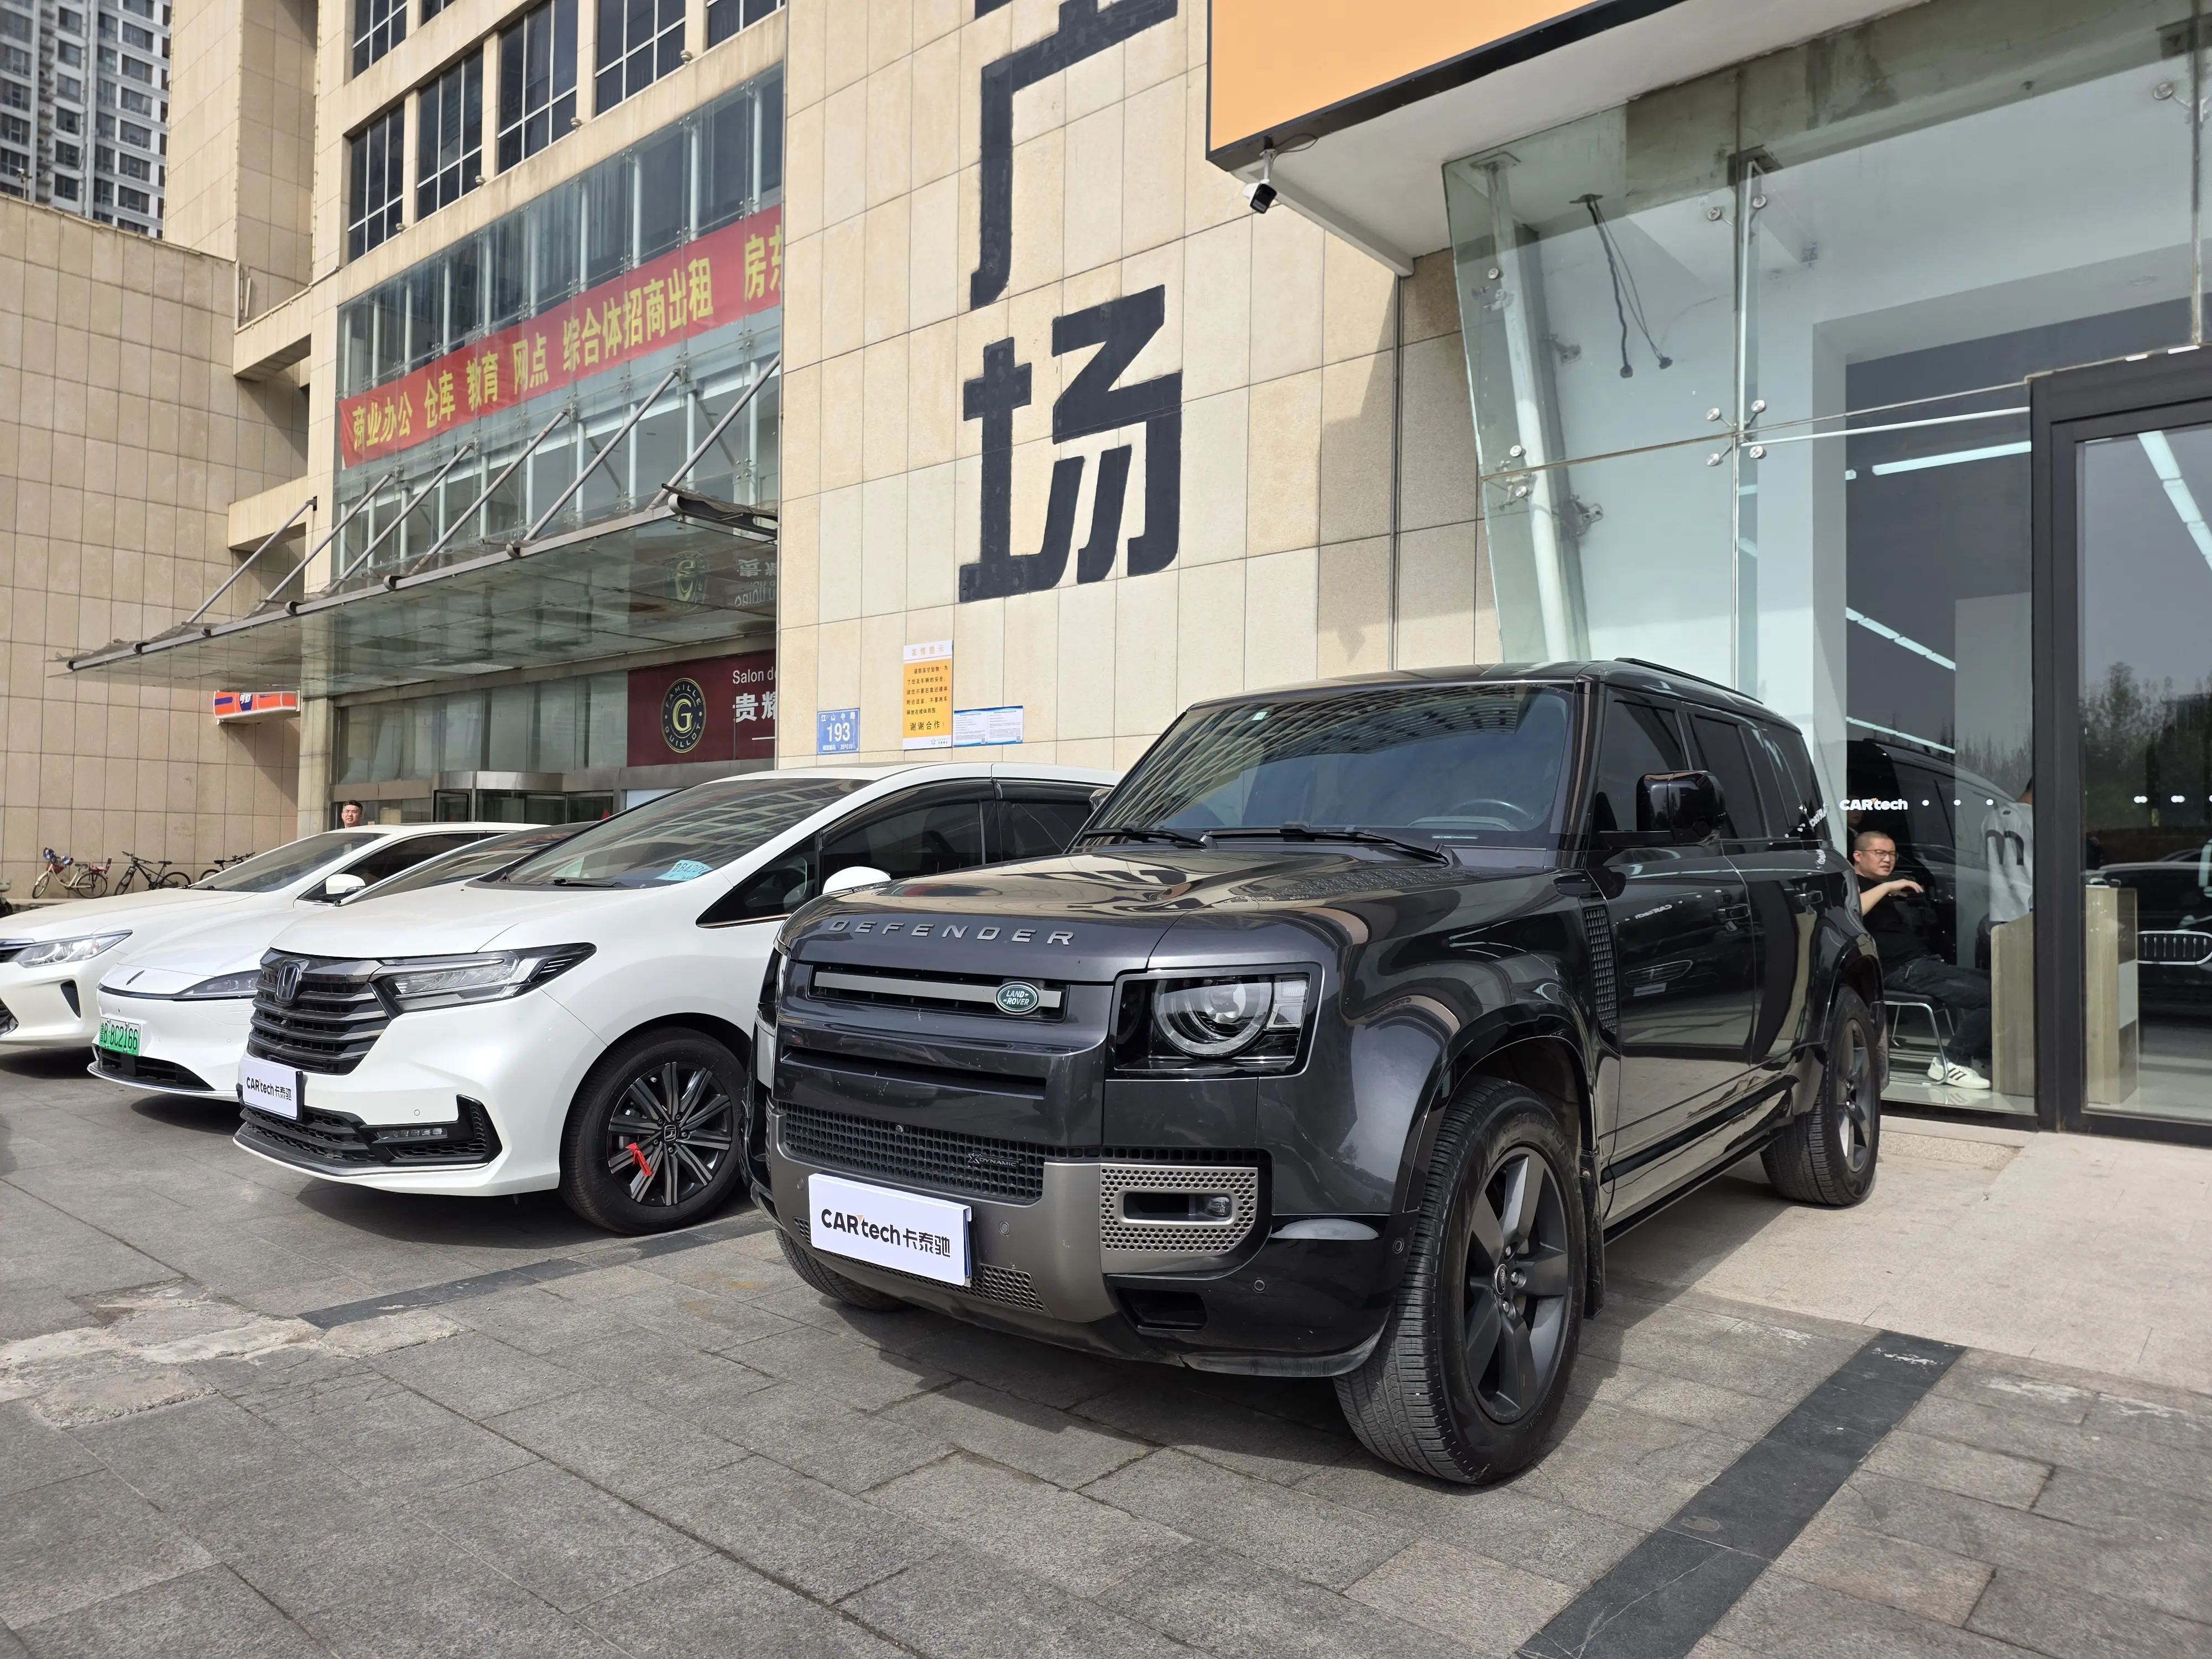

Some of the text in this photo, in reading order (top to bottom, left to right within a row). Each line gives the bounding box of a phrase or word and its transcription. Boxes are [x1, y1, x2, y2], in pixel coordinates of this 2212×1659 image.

[352, 391, 413, 452] 商业办公
[424, 368, 456, 429] 仓库
[466, 350, 499, 412] 教育
[513, 332, 549, 395] 网点
[563, 258, 714, 372] 综合体招商出租
[732, 666, 776, 684] Salon d
[665, 684, 701, 708] FAMILLE
[672, 698, 693, 733] G
[827, 722, 851, 742] 193
[1839, 799, 1908, 811] CARtech
[828, 919, 1074, 946] DEFENDER
[1006, 990, 1025, 998] LAND
[1006, 997, 1030, 1005] ROVER
[979, 1157, 1016, 1167] DYNAMIC
